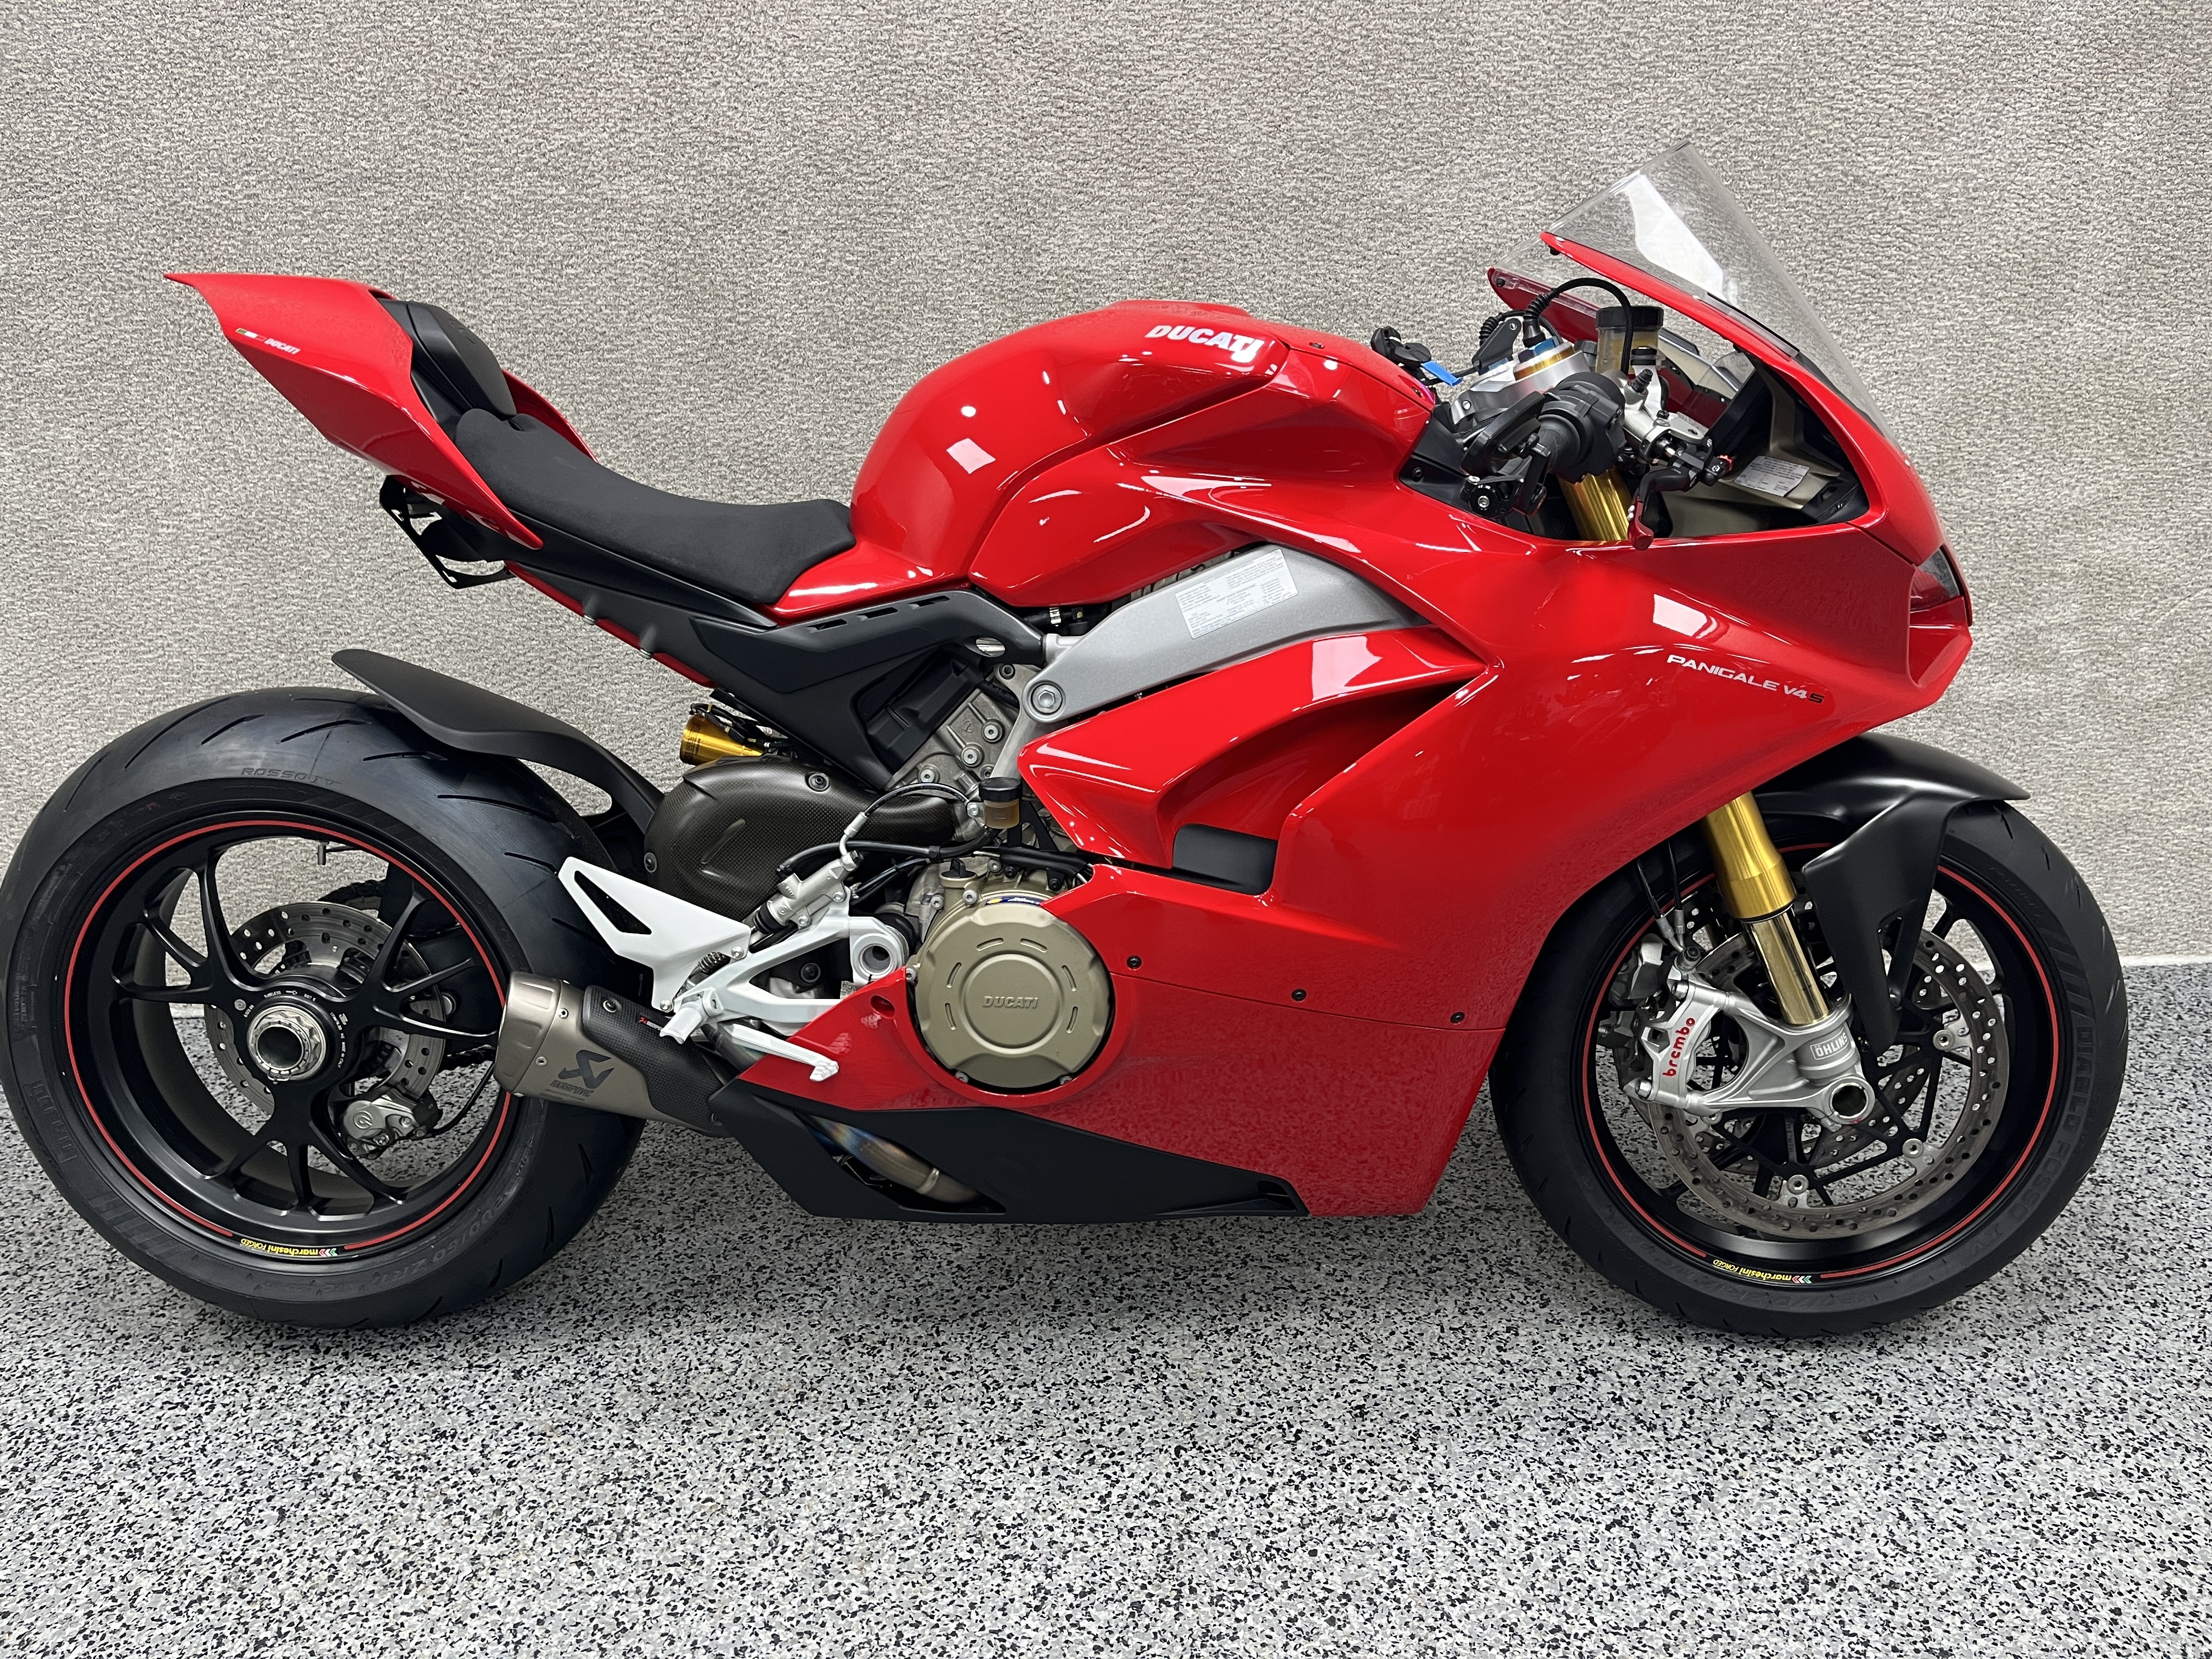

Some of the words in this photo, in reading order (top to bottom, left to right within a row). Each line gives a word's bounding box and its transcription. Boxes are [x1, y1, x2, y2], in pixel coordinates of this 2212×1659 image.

[264, 338, 301, 355] DUCATI
[1144, 325, 1265, 353] DUCATI
[1666, 654, 1780, 691] PANIGALE
[240, 768, 309, 781] ROSSO
[982, 996, 1039, 1009] DUCATI
[1662, 1018, 1695, 1077] brembo
[1814, 1032, 1848, 1057] ÖHLINS
[2063, 1026, 2095, 1134] DIABLO
[2009, 1139, 2072, 1222] ROSSO
[240, 1238, 266, 1251] FORGED
[266, 1244, 319, 1257] marchesini
[1713, 1259, 1740, 1272] FORGED
[1738, 1267, 1792, 1281] marchesini
